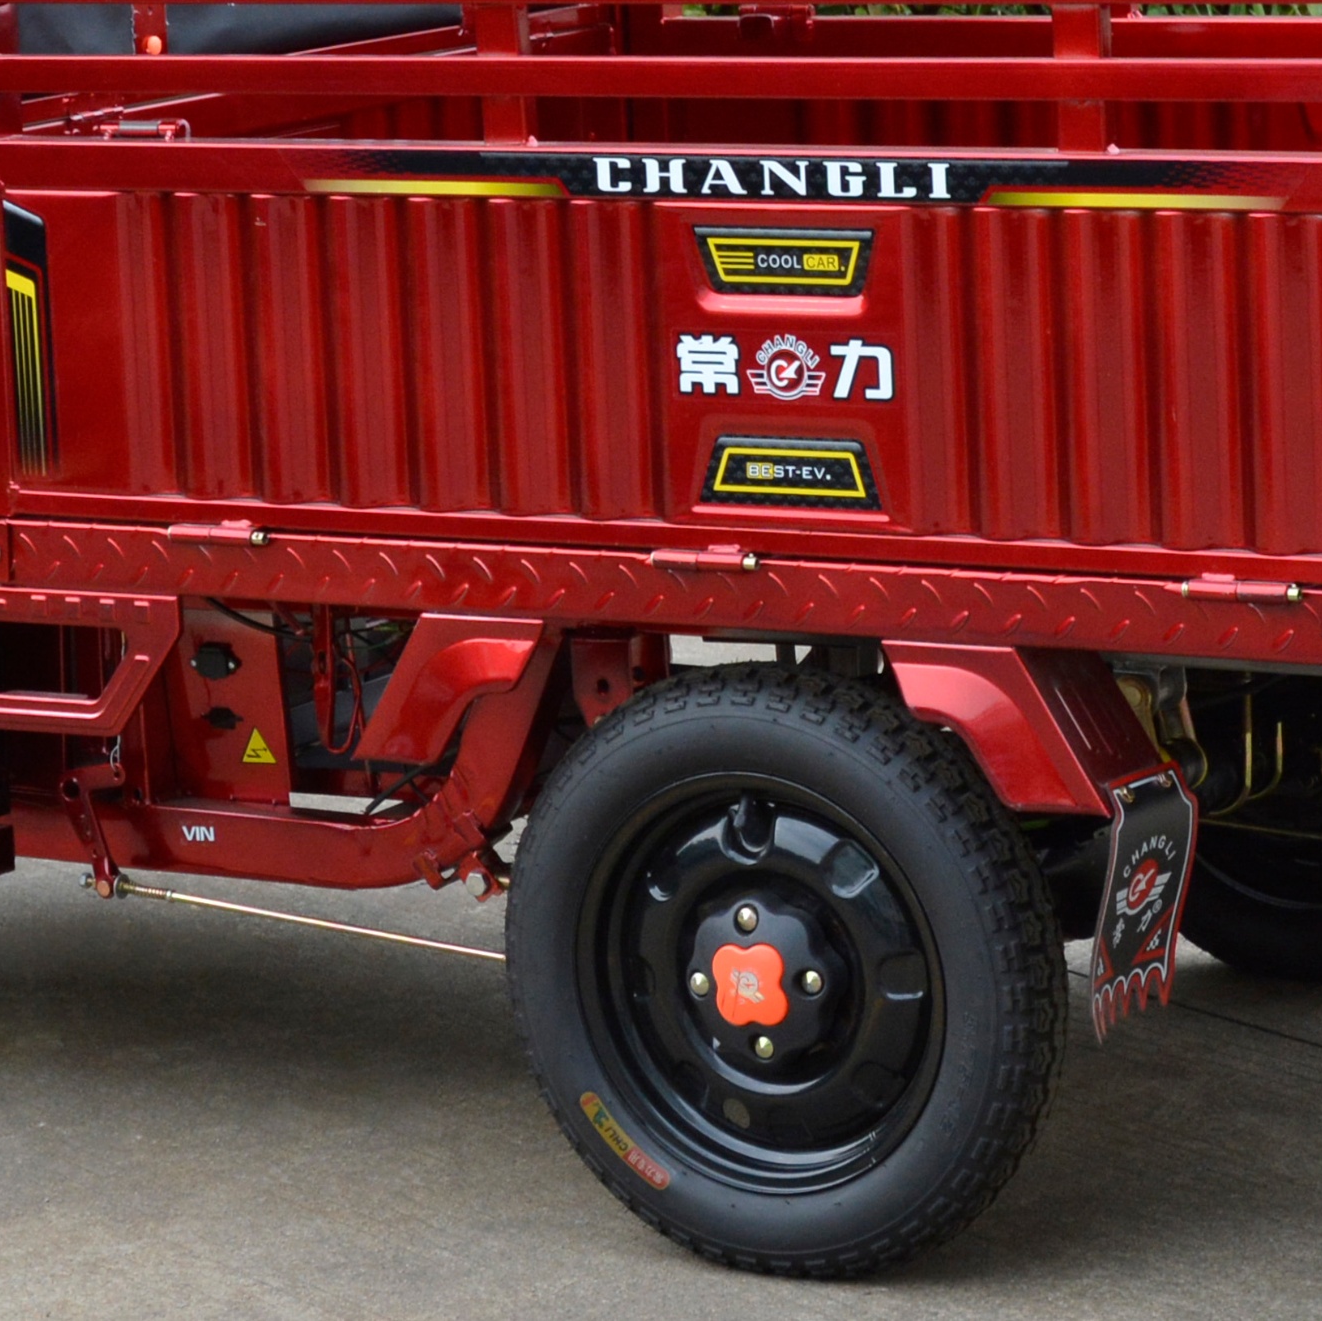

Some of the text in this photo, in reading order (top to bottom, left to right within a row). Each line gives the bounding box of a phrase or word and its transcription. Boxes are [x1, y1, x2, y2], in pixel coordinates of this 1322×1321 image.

[592, 156, 952, 199] CHANGLI
[757, 254, 802, 269] COOL
[755, 333, 821, 369] CHANGLI
[181, 825, 215, 842] VIN
[1123, 835, 1177, 878] CHANGLI
